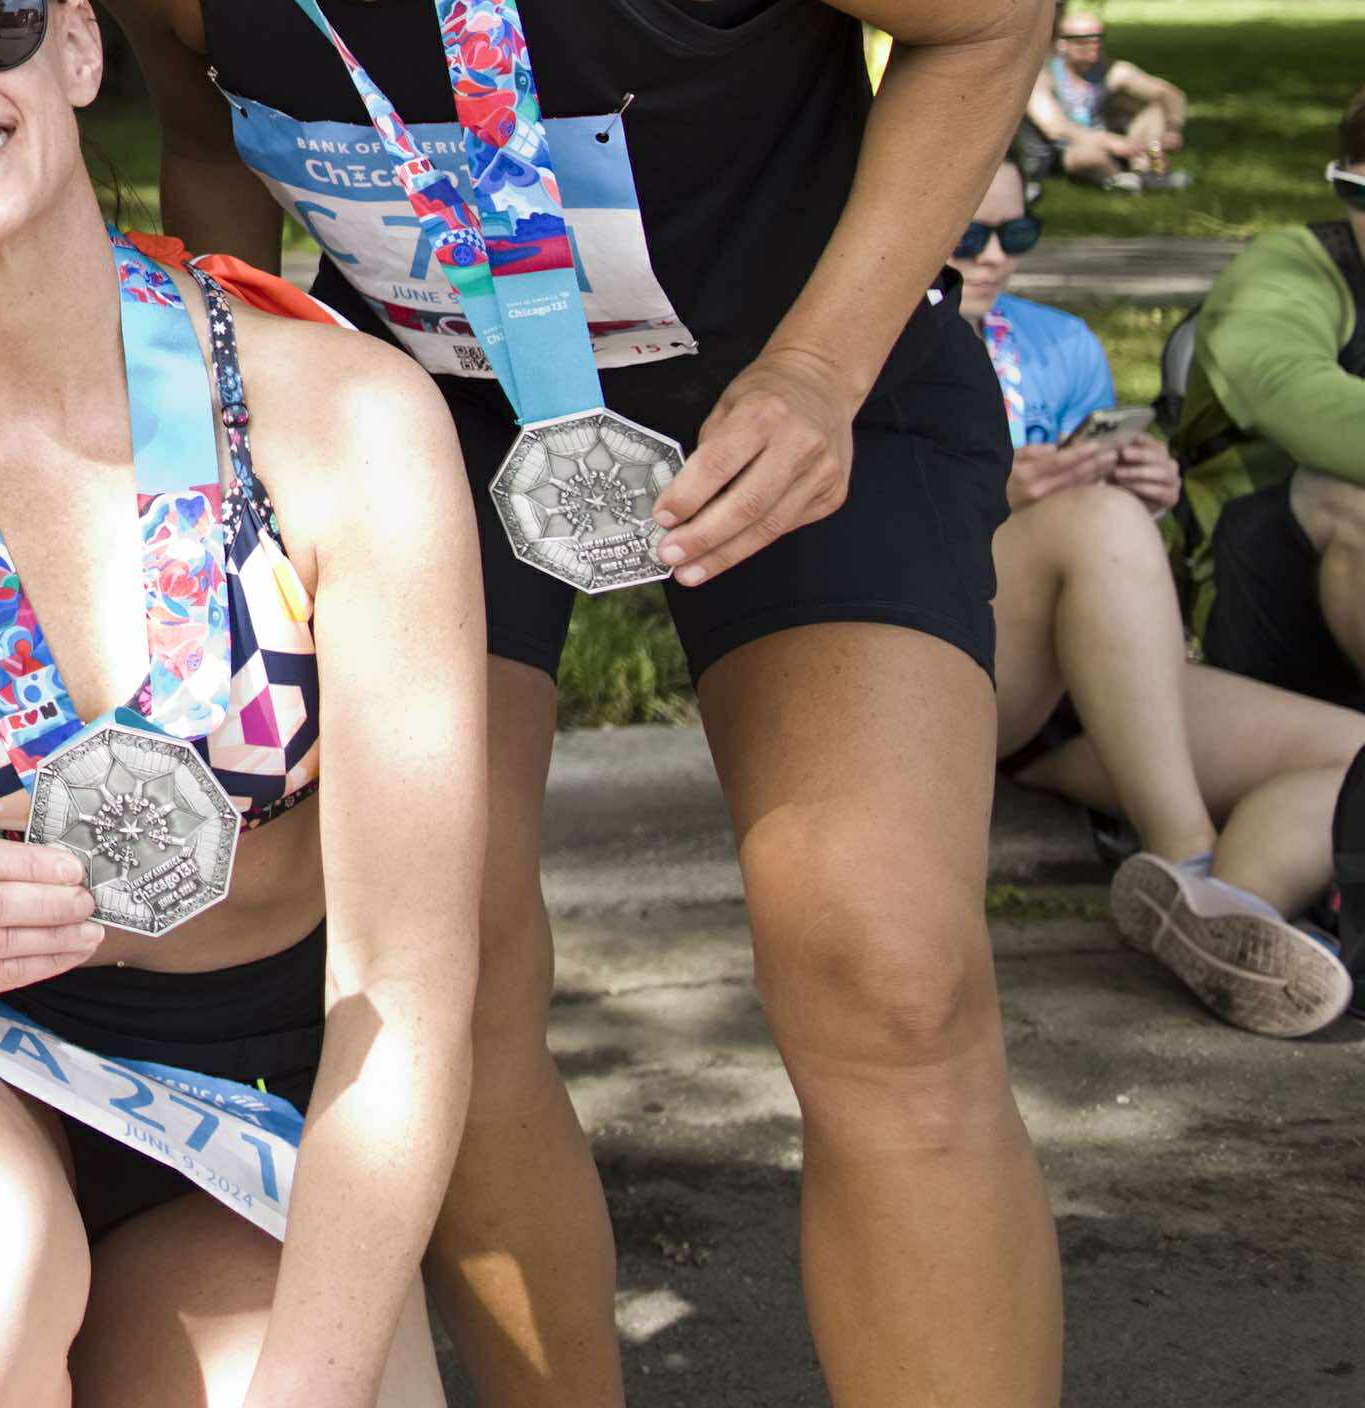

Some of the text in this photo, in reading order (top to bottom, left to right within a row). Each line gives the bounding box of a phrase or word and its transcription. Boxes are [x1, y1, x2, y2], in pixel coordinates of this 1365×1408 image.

[296, 137, 350, 154] BANK
[356, 142, 381, 154] OF
[392, 284, 442, 305] JUNE
[631, 343, 662, 356] 15
[206, 1168, 254, 1209] 2024
